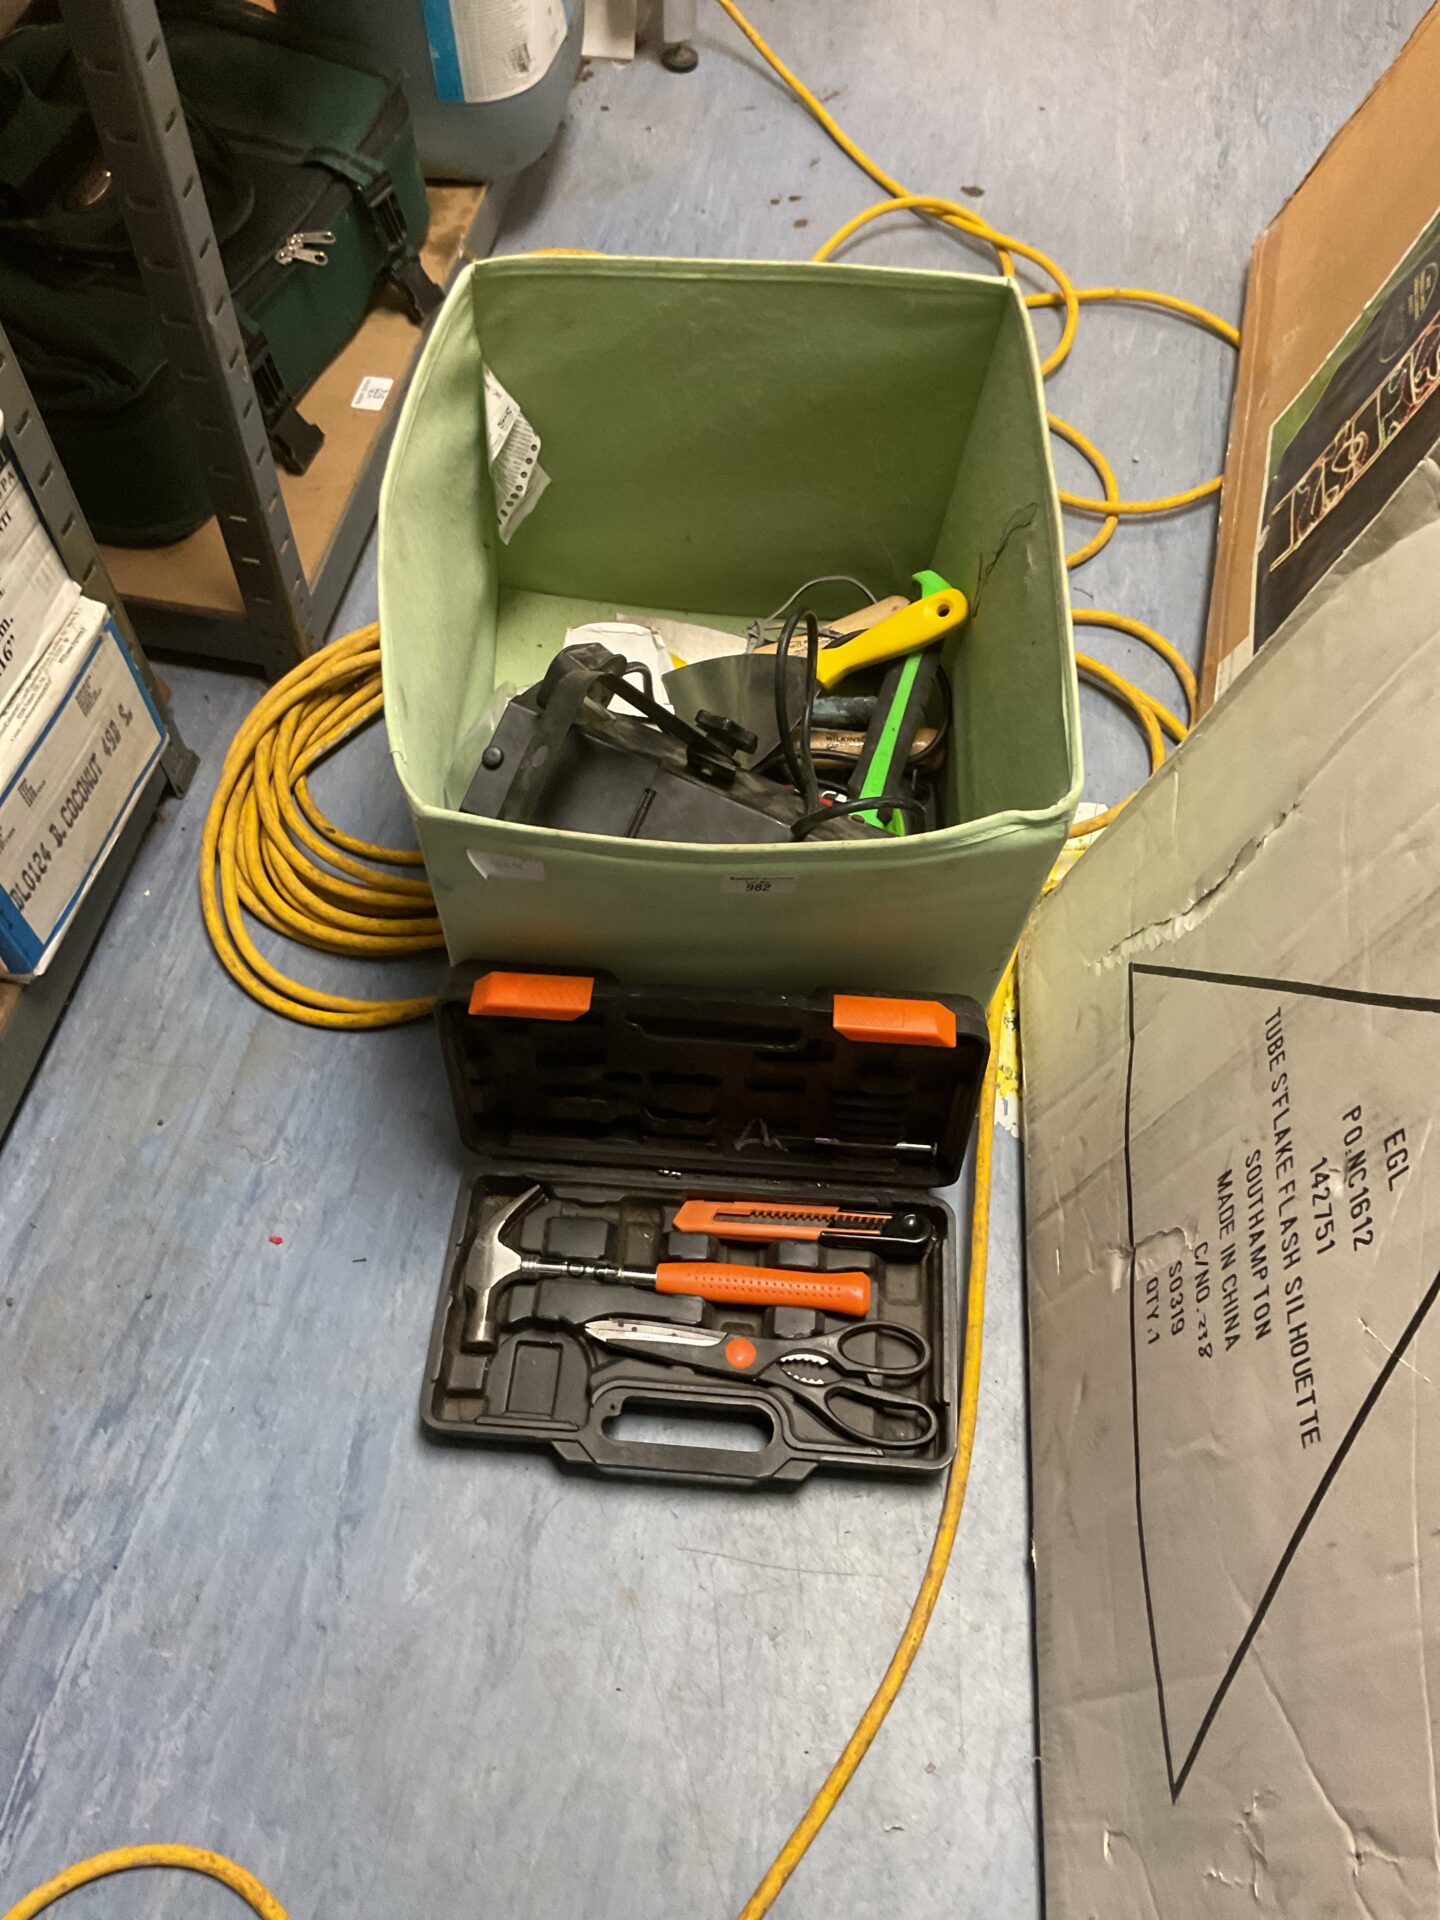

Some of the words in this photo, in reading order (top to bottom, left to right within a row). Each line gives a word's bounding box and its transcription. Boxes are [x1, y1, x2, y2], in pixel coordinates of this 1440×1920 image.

[746, 883, 771, 892] 982
[1265, 1007, 1286, 1072] TUBE
[1271, 1072, 1294, 1180] S'FLAKE
[1383, 1128, 1410, 1192] EGL
[1217, 1169, 1236, 1240] MADE
[1278, 1179, 1302, 1270] FLASH
[1310, 1157, 1337, 1255] 142751
[1220, 1243, 1237, 1270] IN
[1222, 1274, 1241, 1351] CHINA
[1285, 1275, 1321, 1449] SILHOUETTE
